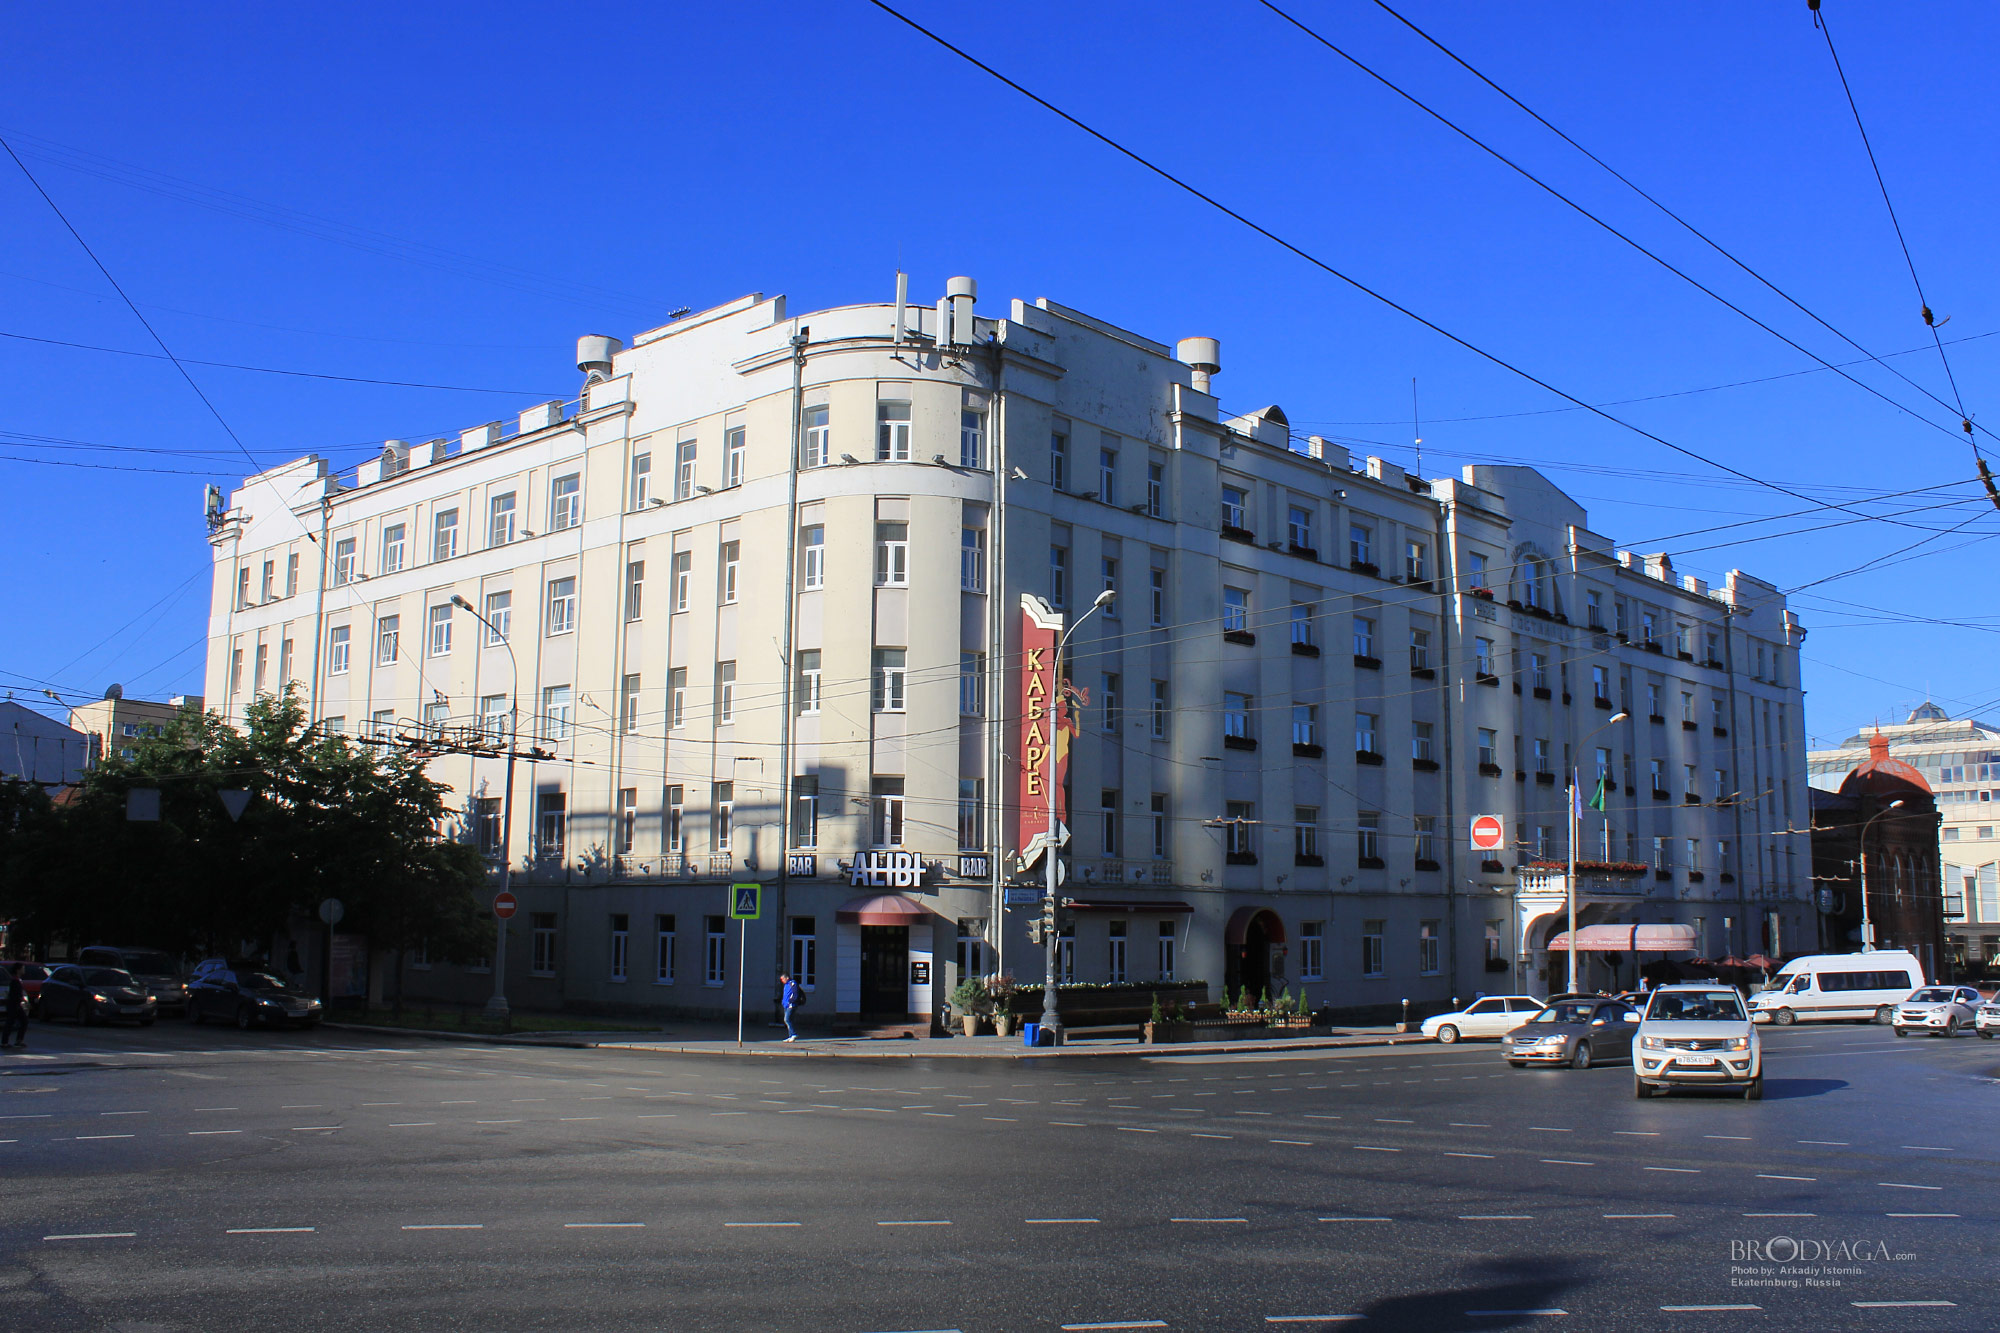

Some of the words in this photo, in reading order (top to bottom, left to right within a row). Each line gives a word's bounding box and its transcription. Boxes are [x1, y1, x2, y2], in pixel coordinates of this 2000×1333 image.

[1025, 647, 1046, 796] КАБАРЕ
[789, 856, 813, 876] BAR
[850, 851, 922, 887] ALIBI
[961, 857, 987, 877] BAR
